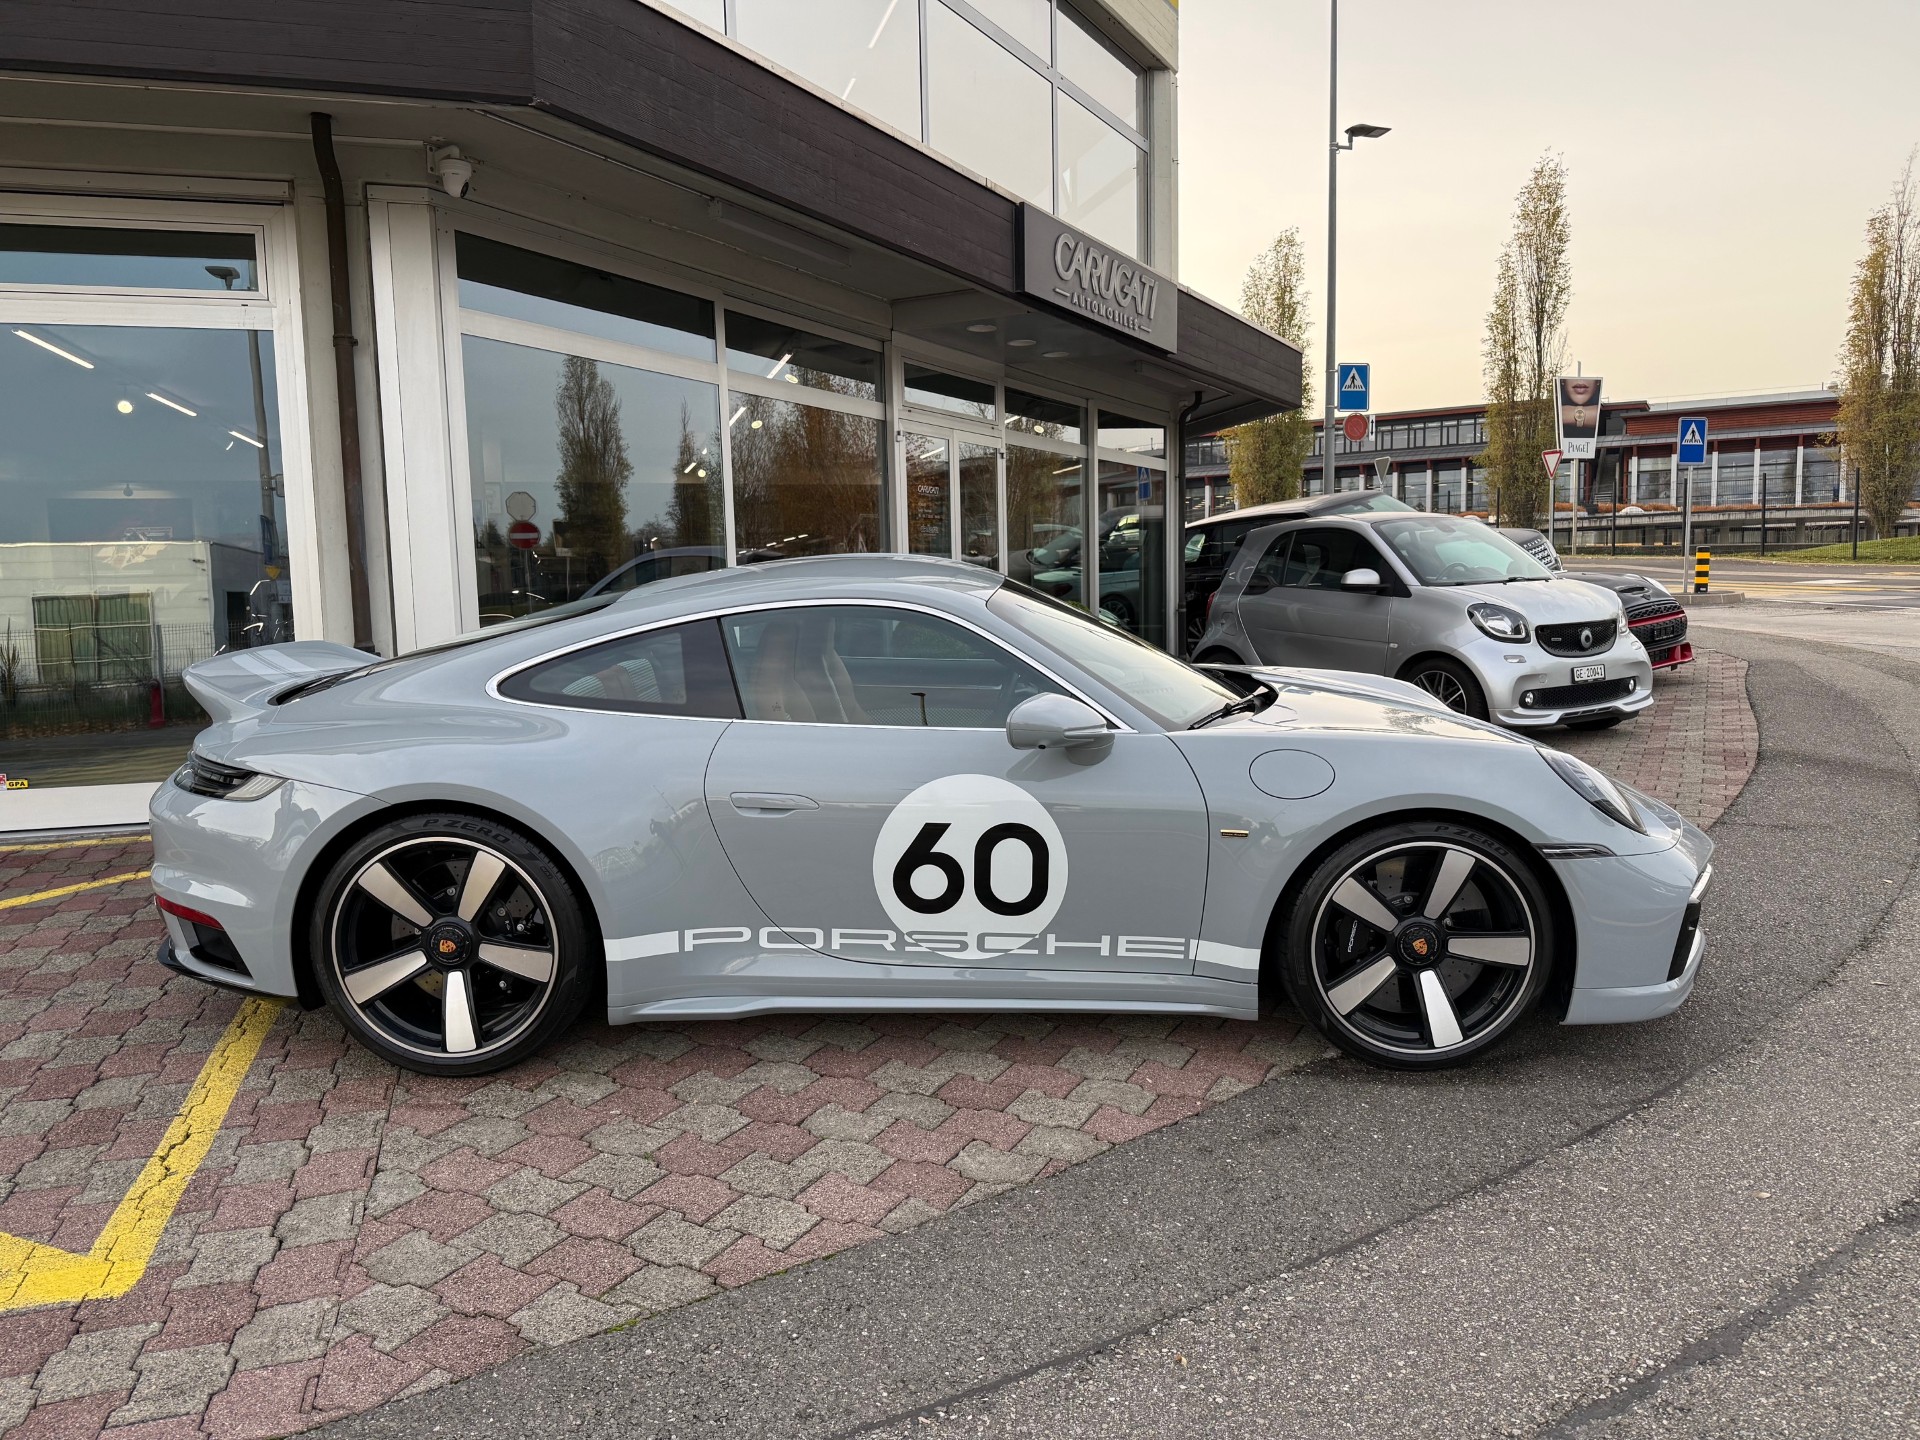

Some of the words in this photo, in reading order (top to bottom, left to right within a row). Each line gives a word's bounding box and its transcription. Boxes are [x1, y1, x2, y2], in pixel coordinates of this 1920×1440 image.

[1054, 233, 1159, 321] CARUGATI
[1072, 292, 1139, 331] AUTOMOBILES
[1568, 441, 1590, 454] PIAGET
[423, 818, 440, 828] P
[442, 819, 512, 845] ZERO
[1452, 828, 1510, 857] ZERO
[892, 822, 1050, 917] 60
[684, 926, 1186, 960] PORSCHE
